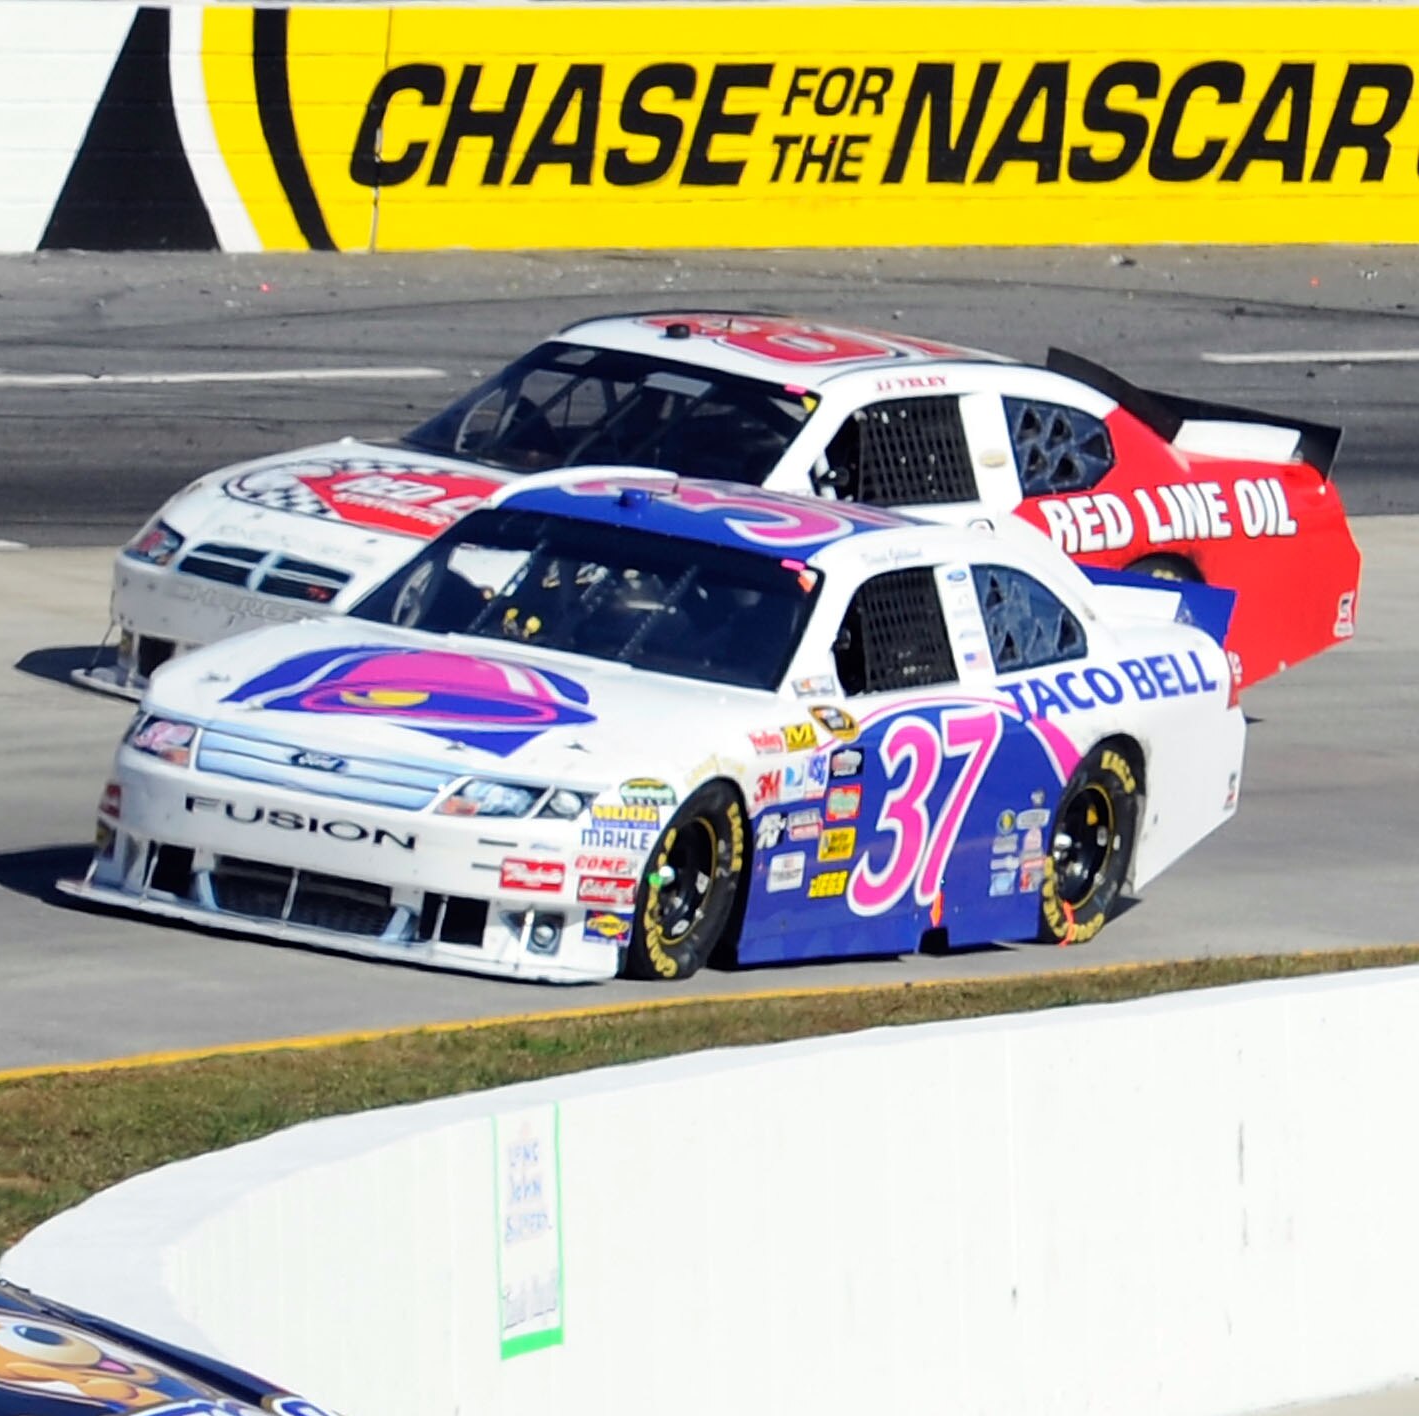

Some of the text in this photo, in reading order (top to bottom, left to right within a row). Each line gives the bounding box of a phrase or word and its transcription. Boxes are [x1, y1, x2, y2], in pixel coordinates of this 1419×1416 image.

[349, 60, 1414, 190] CHASE FOR THE NASCAR
[1039, 478, 1298, 555] RED LINE OIL
[997, 649, 1218, 723] TACO BELL
[184, 796, 417, 851] FUSION
[581, 829, 649, 850] MAHLE
[847, 706, 1006, 915] 37
